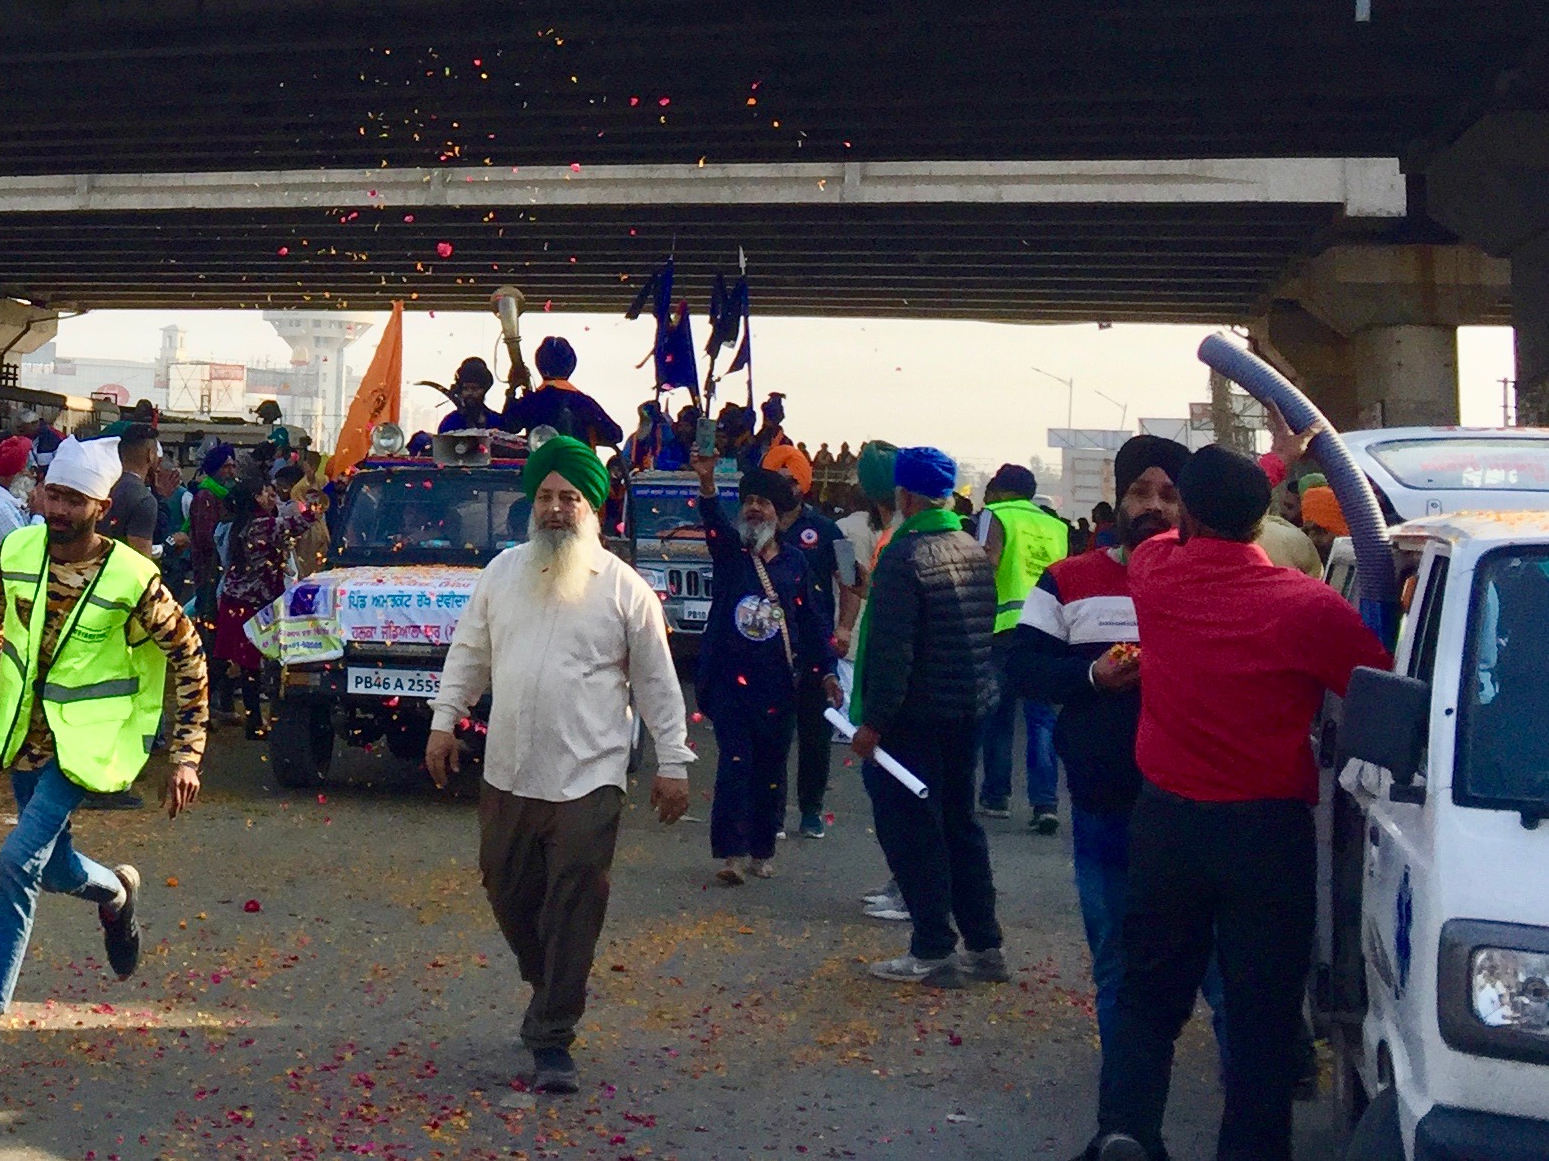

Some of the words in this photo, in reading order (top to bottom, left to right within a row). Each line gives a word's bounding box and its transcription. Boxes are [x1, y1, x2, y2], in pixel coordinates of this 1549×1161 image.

[347, 589, 368, 610] ਪਿੰਡ
[351, 625, 377, 640] ਹਲਕਾ
[354, 675, 391, 690] PB46
[393, 678, 404, 691] A
